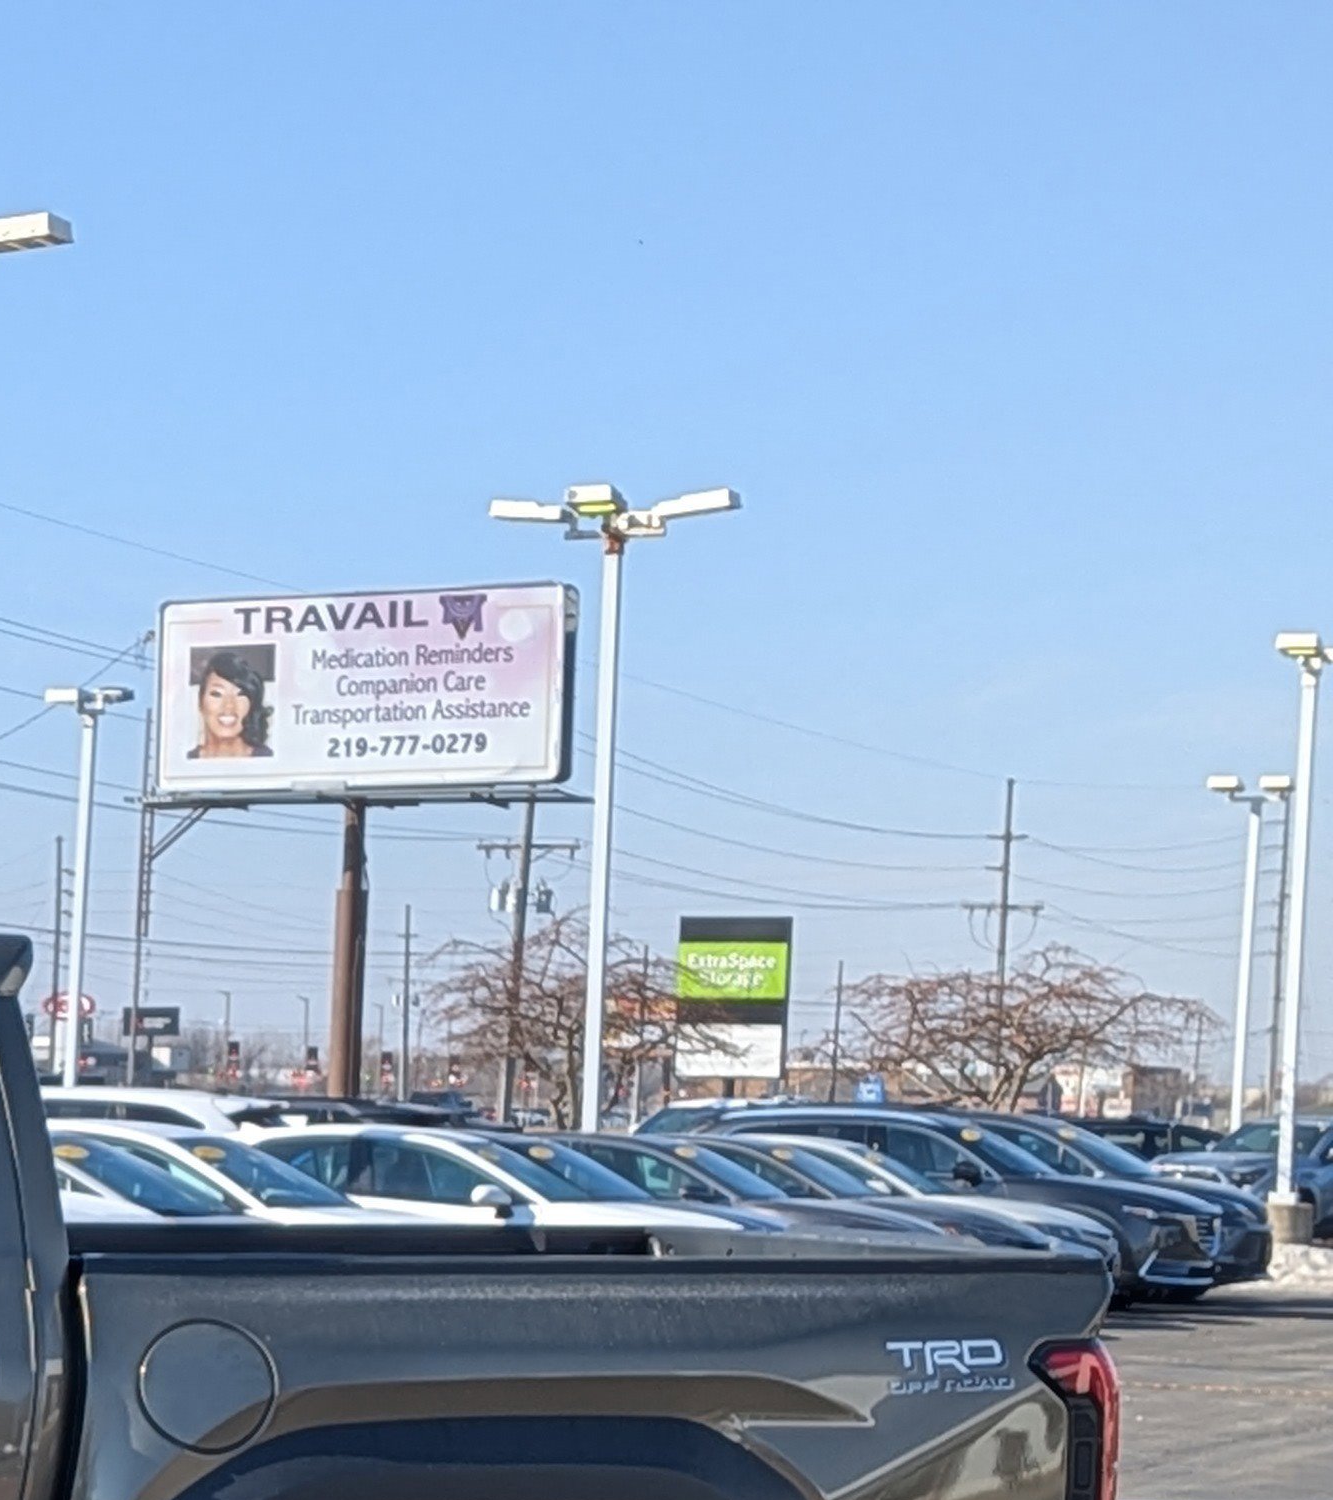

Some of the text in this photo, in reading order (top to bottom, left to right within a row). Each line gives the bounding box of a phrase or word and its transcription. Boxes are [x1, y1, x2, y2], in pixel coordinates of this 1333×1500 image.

[234, 600, 429, 634] TRAVAIL
[312, 642, 514, 669] Medication Reminders
[336, 670, 486, 699] Companion Care
[292, 698, 530, 728] Transportation Assistance
[328, 733, 487, 757] 219-777-0279
[885, 1338, 1004, 1376] TRD
